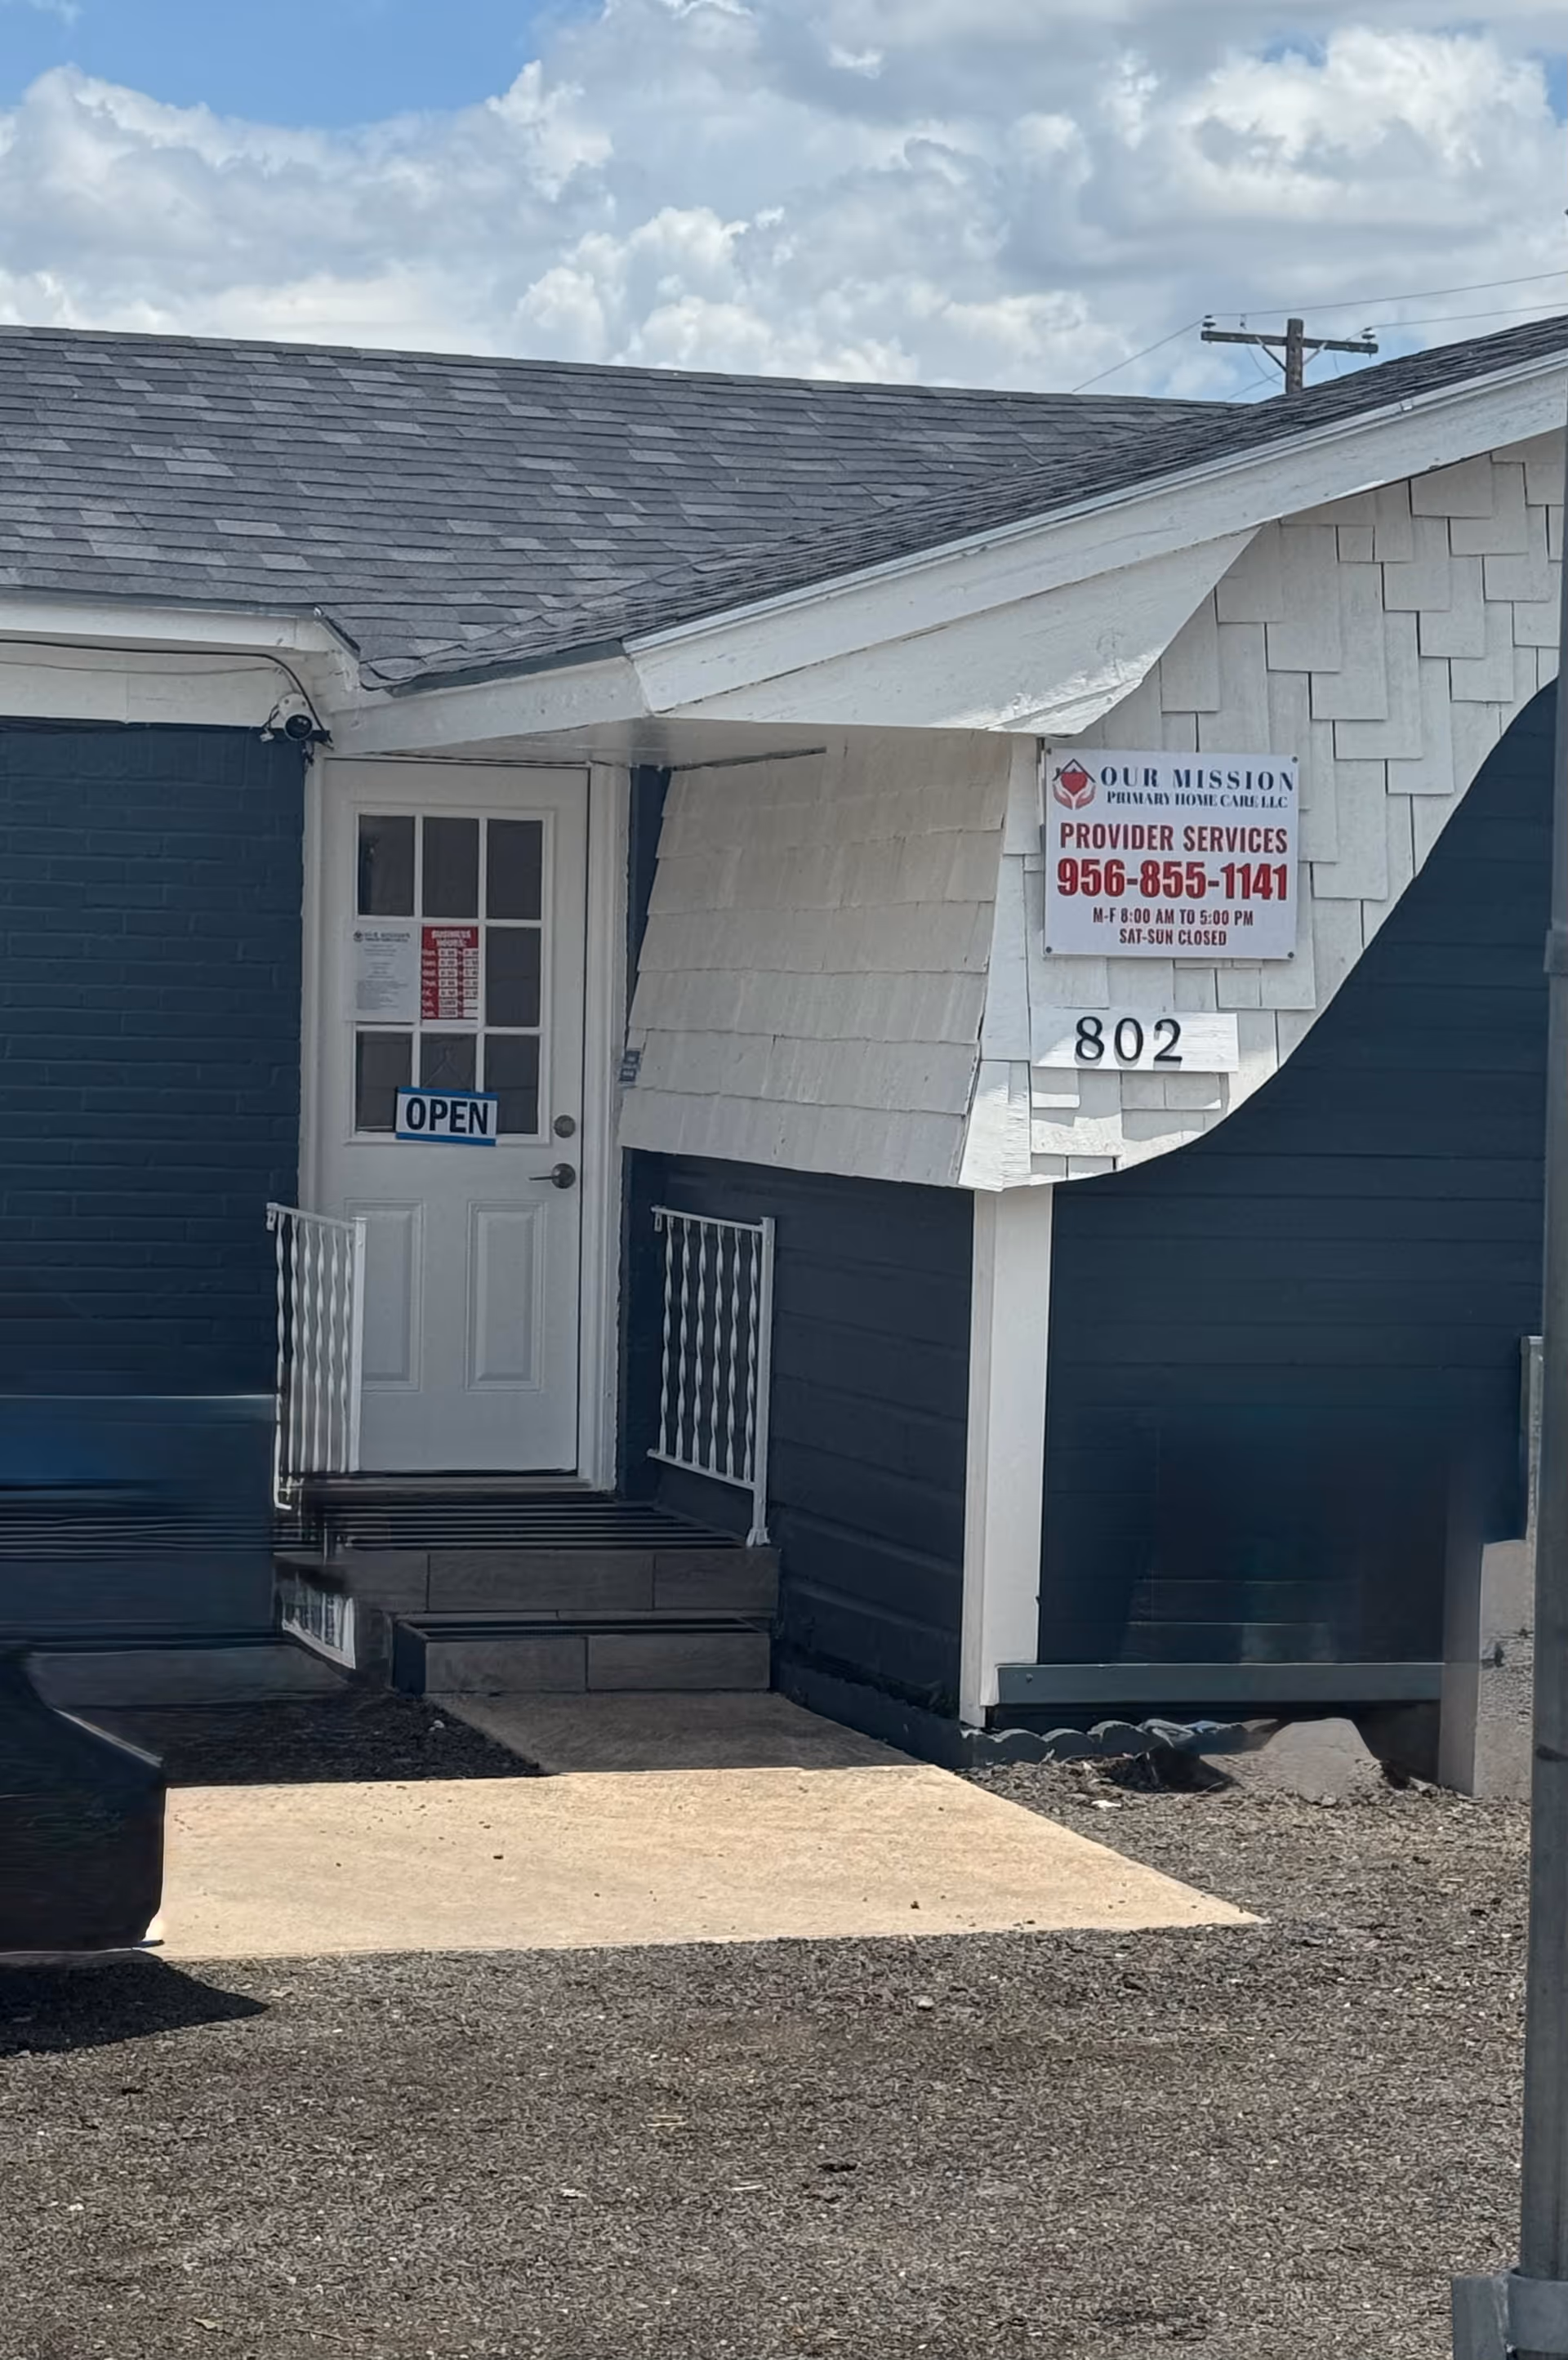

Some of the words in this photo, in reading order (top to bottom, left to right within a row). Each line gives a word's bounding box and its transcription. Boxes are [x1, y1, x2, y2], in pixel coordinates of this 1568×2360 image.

[1100, 766, 1158, 788] OUR
[1173, 768, 1294, 792] MISSION
[1107, 790, 1169, 806] PRIMARY
[1174, 792, 1218, 807] HOME
[1219, 794, 1258, 808] CARE
[1261, 795, 1288, 809] LLC
[1059, 822, 1174, 851] PROVIDER
[1183, 826, 1289, 854] SERVICES
[1056, 857, 1288, 902] 956-855-1141
[1093, 906, 1116, 924] M-F
[1120, 907, 1151, 924] 8:00
[1155, 908, 1175, 925] AM
[1178, 909, 1196, 925] TO
[1199, 909, 1230, 926] 5:00
[1234, 910, 1254, 927] PM
[1119, 928, 1174, 945] SAT-SUN
[1178, 929, 1227, 946] CLOSED
[1075, 1016, 1183, 1062] 802
[406, 1097, 488, 1135] OPEN
